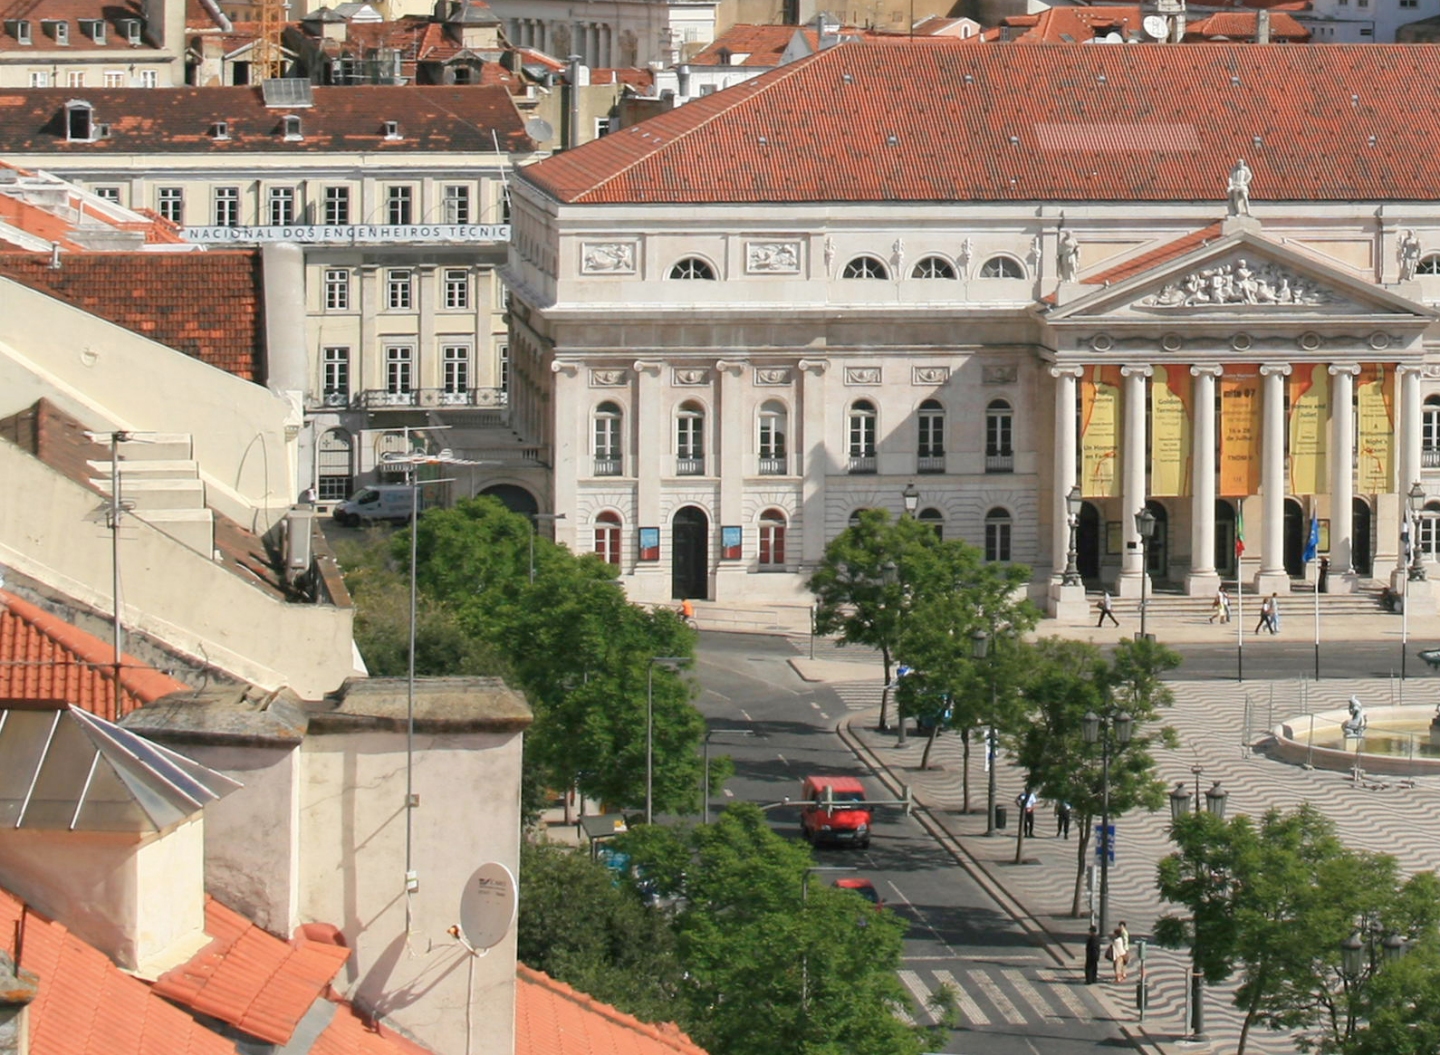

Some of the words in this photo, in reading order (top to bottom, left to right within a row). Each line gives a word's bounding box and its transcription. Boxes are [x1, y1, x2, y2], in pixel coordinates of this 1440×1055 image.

[189, 228, 273, 239] NACIONAL
[283, 228, 315, 238] DOS
[324, 227, 440, 238] ENGENHEIROS
